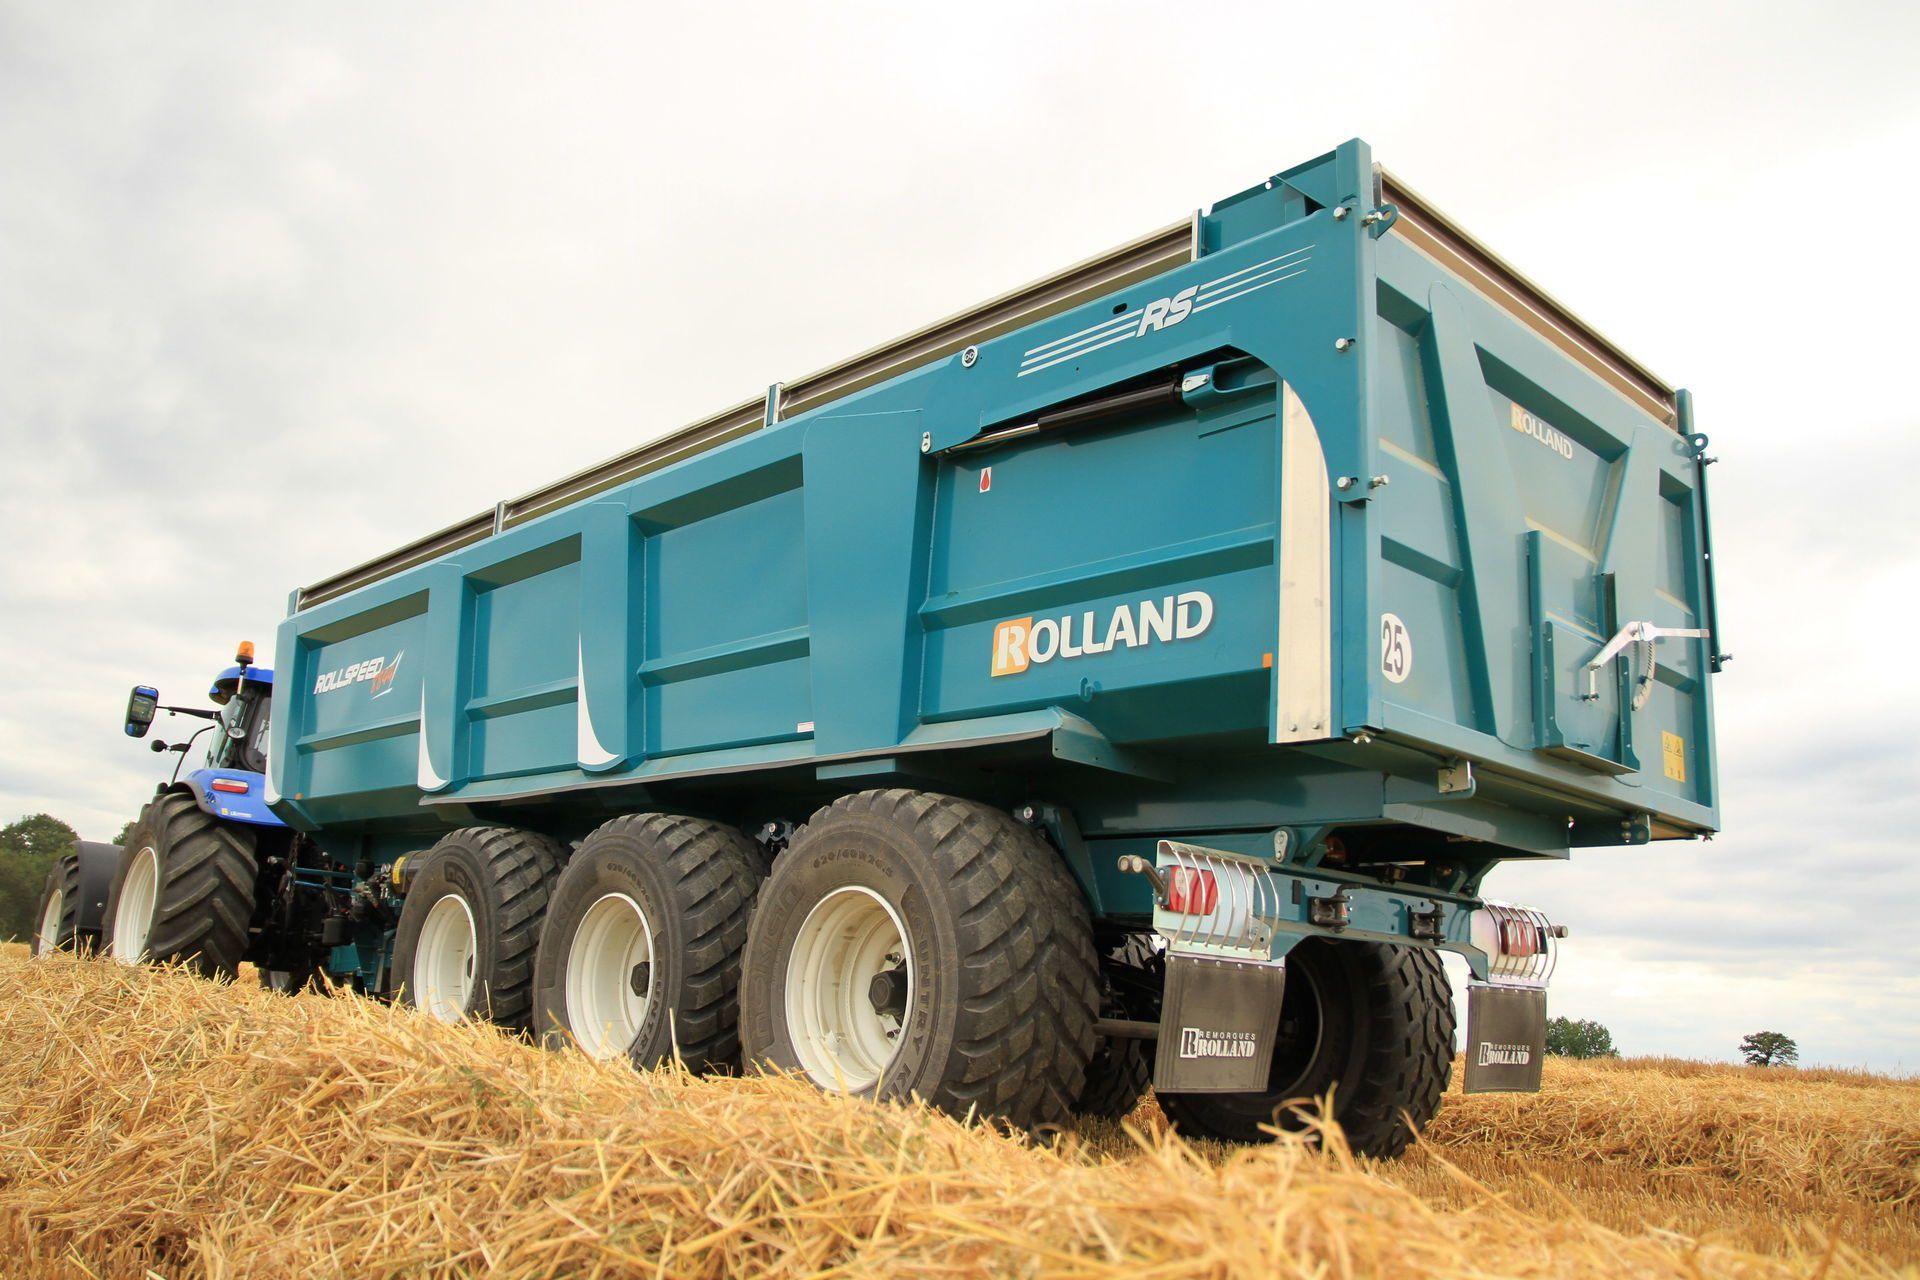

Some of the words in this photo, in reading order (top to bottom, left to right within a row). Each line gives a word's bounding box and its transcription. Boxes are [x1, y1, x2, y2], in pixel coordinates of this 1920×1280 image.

[1136, 285, 1199, 338] RS
[1511, 402, 1573, 459] ROLLAND
[994, 591, 1214, 671] ROLLAND
[1382, 620, 1404, 676] 25
[313, 656, 384, 694] ROLLSPEED
[1197, 1039, 1256, 1057] ROLLAND
[1199, 1030, 1256, 1041] REMORQUES
[1488, 1050, 1530, 1065] ROLLAND
